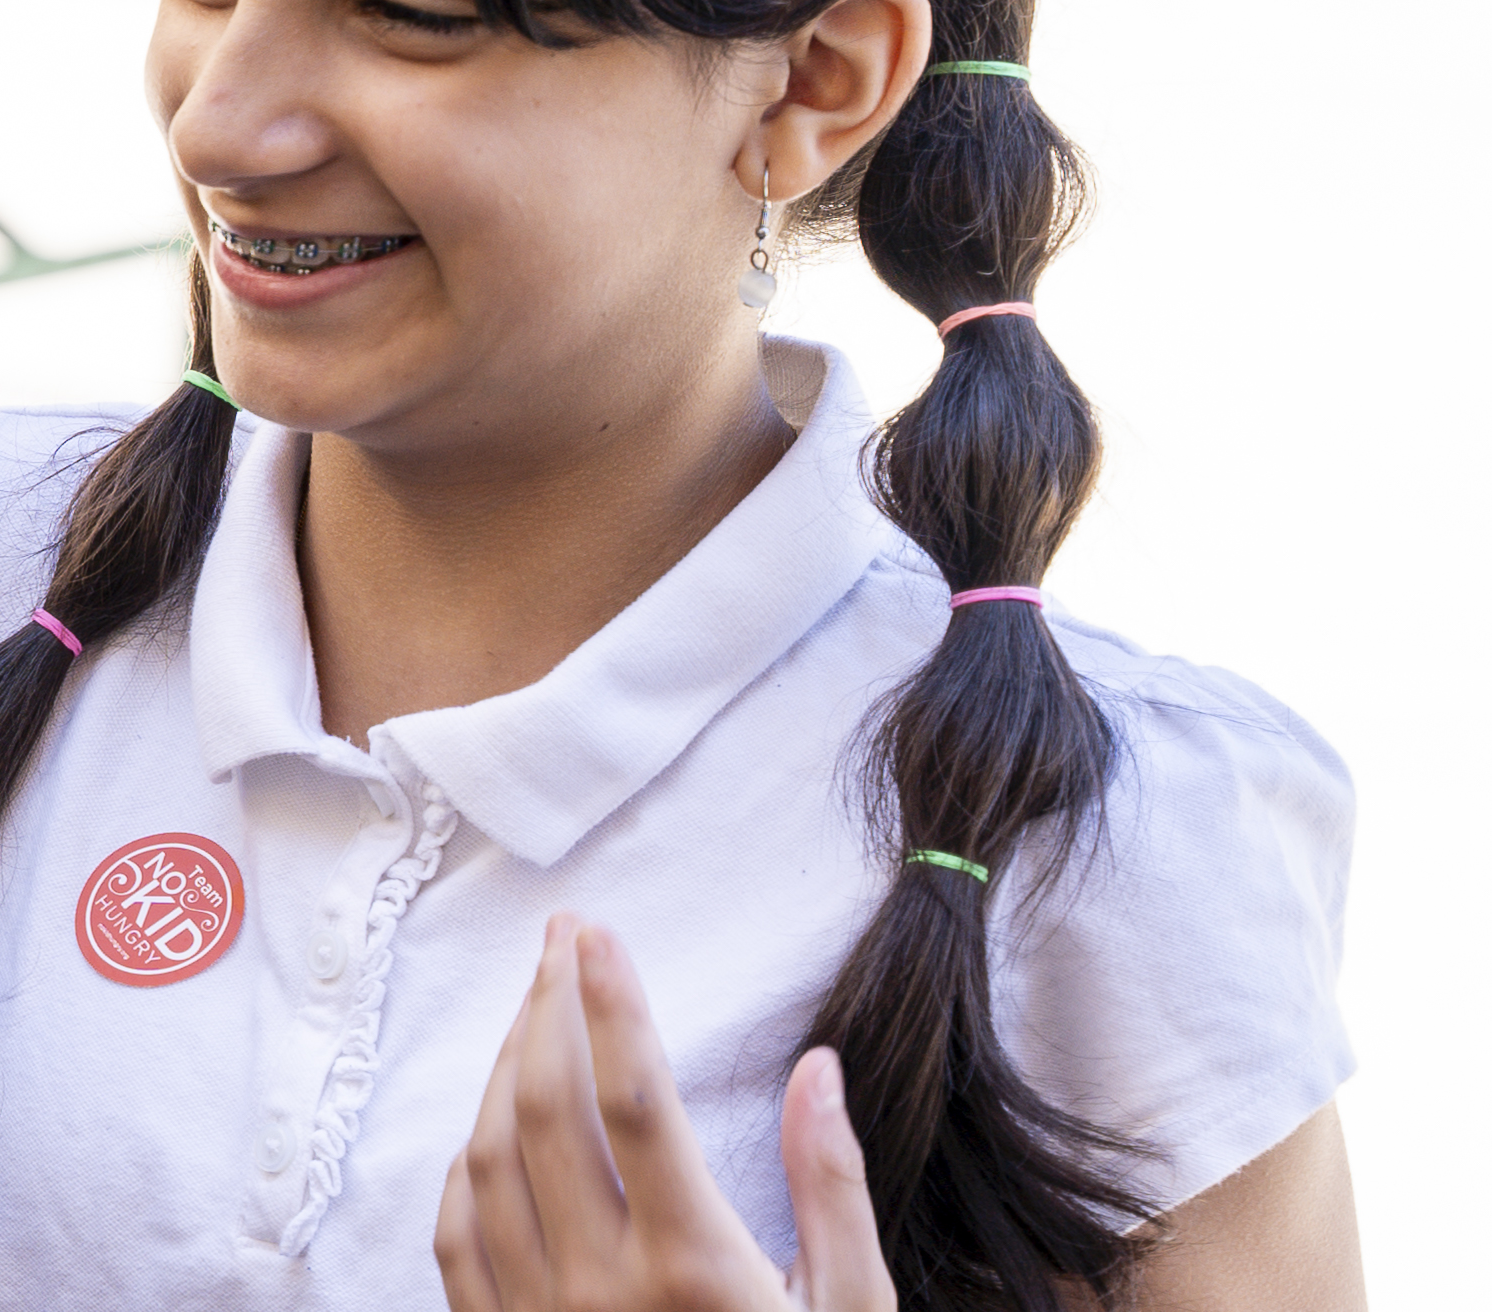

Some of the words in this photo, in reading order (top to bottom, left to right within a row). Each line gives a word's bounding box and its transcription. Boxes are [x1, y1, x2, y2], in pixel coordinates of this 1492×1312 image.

[143, 851, 187, 894] NO
[188, 864, 224, 908] Team
[94, 894, 161, 966] HUNGRY
[121, 879, 203, 961] KID
